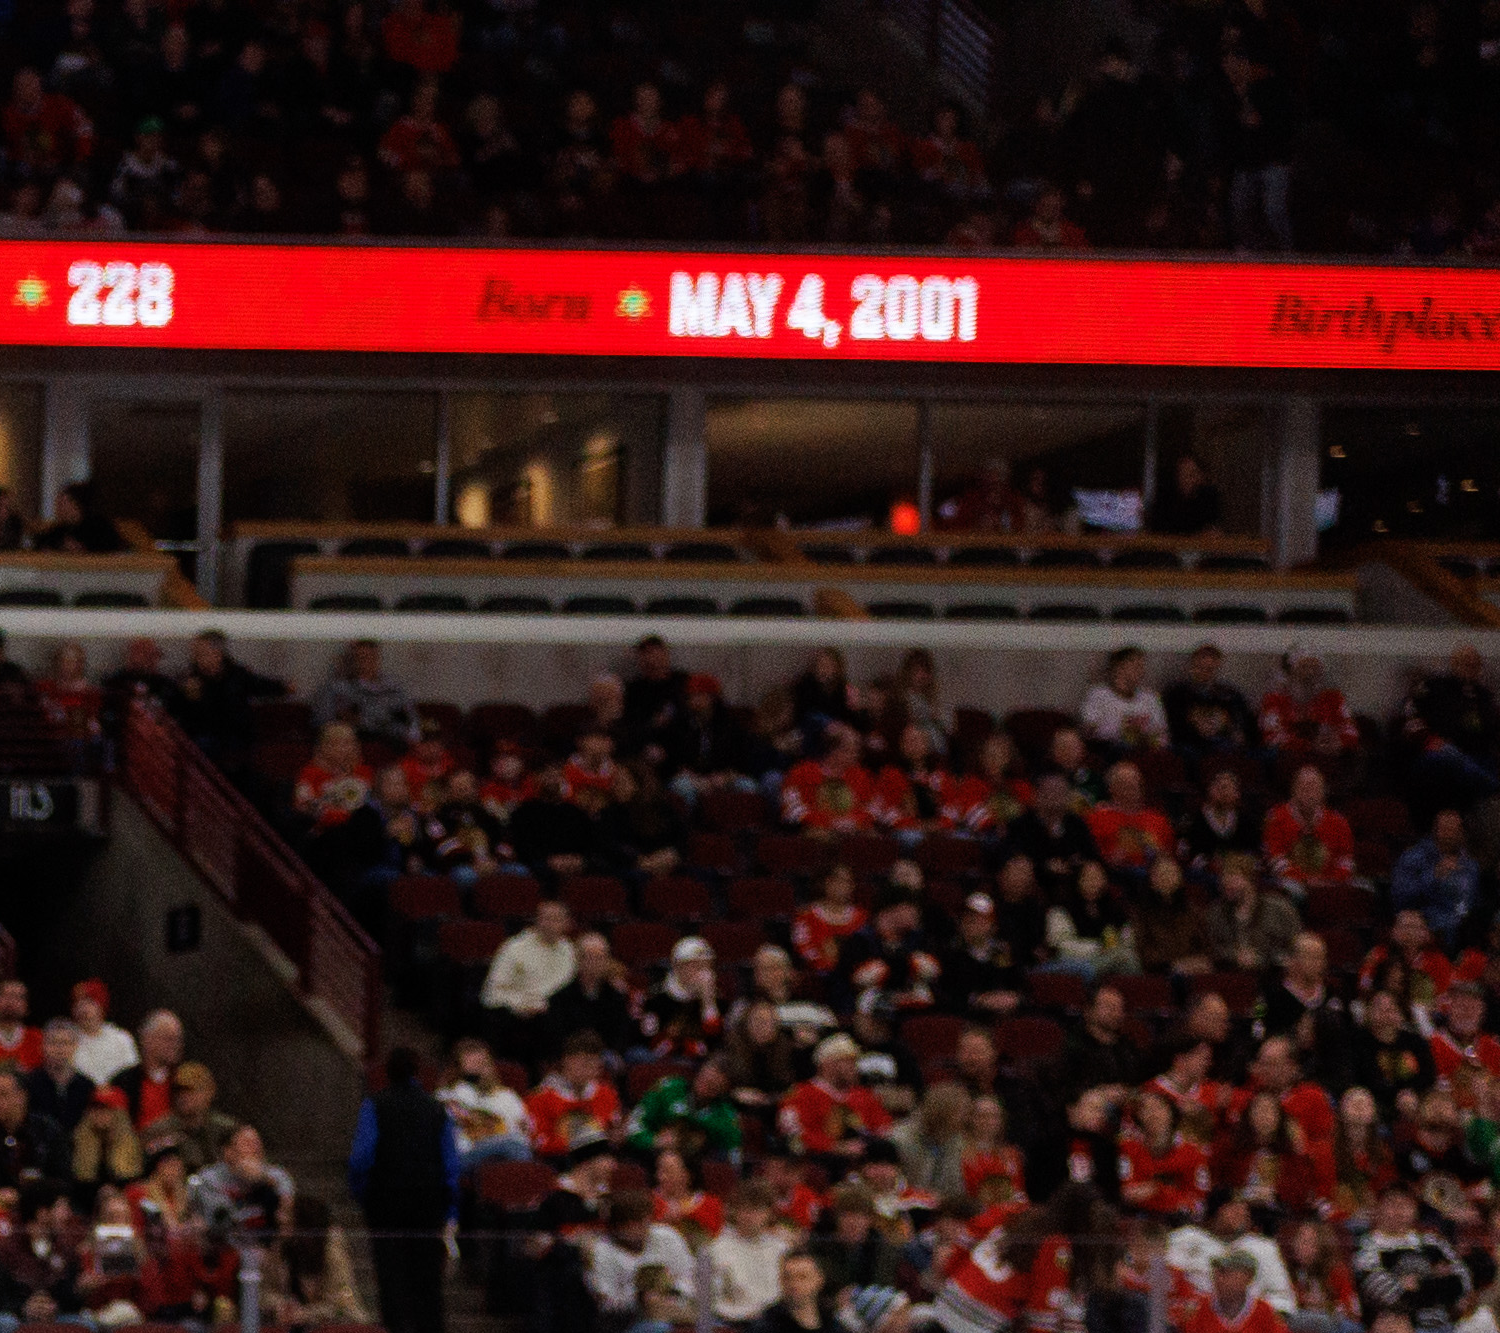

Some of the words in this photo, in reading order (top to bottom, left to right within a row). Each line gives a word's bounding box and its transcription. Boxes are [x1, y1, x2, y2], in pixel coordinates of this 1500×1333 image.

[67, 260, 176, 328] 228
[668, 270, 785, 338] MAY
[787, 273, 842, 348] 4,
[850, 273, 980, 342] 2001
